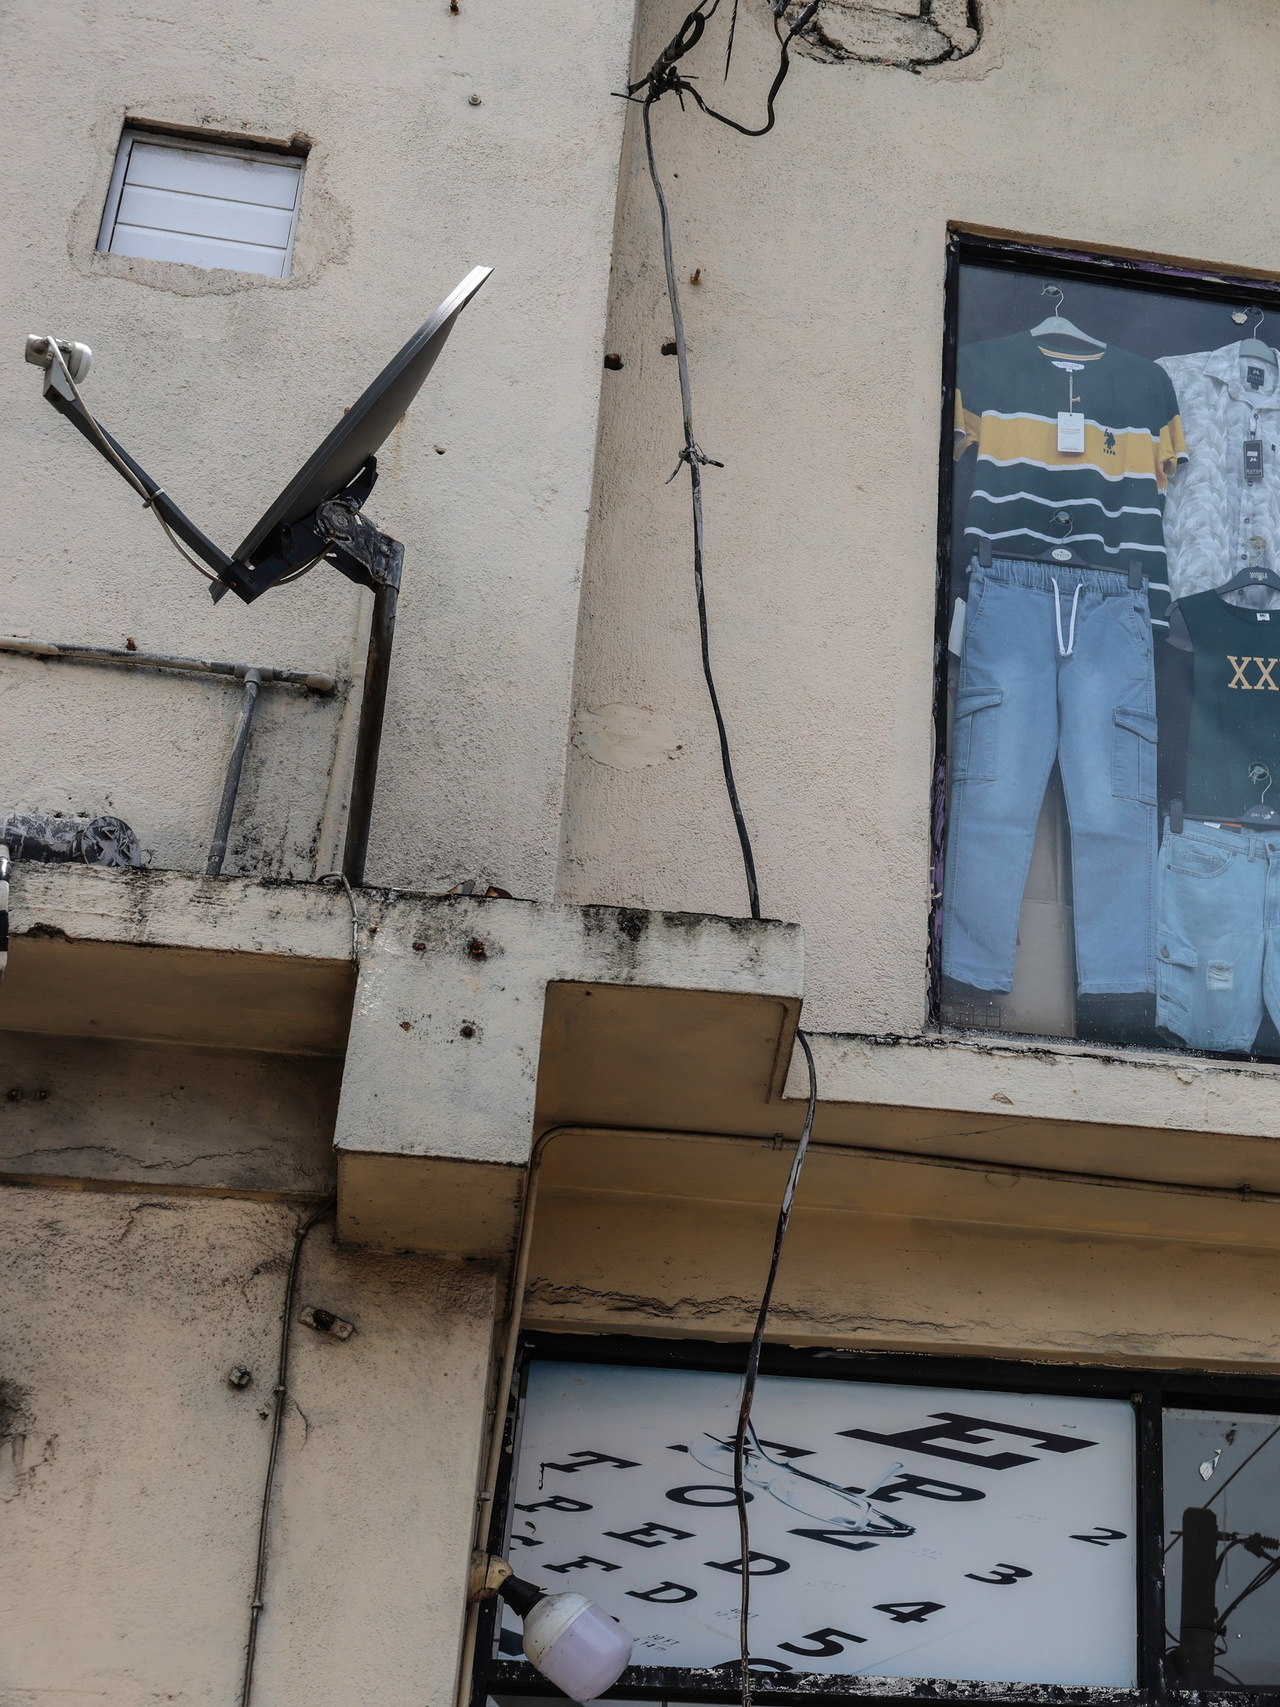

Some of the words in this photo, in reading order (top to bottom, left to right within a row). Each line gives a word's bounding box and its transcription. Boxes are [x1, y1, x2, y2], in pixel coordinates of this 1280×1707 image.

[834, 1412, 1100, 1470] E
[514, 1495, 594, 1512] P
[602, 1521, 697, 1548] E
[703, 1550, 791, 1576] D
[872, 1601, 947, 1624] 4
[543, 1450, 643, 1473] T
[665, 1485, 755, 1507] O
[963, 1563, 1033, 1585] 3
[842, 1473, 987, 1503] P
[1068, 1527, 1128, 1547] 2
[541, 1555, 623, 1574] F
[624, 1581, 698, 1604] D
[776, 1627, 868, 1657] 5
